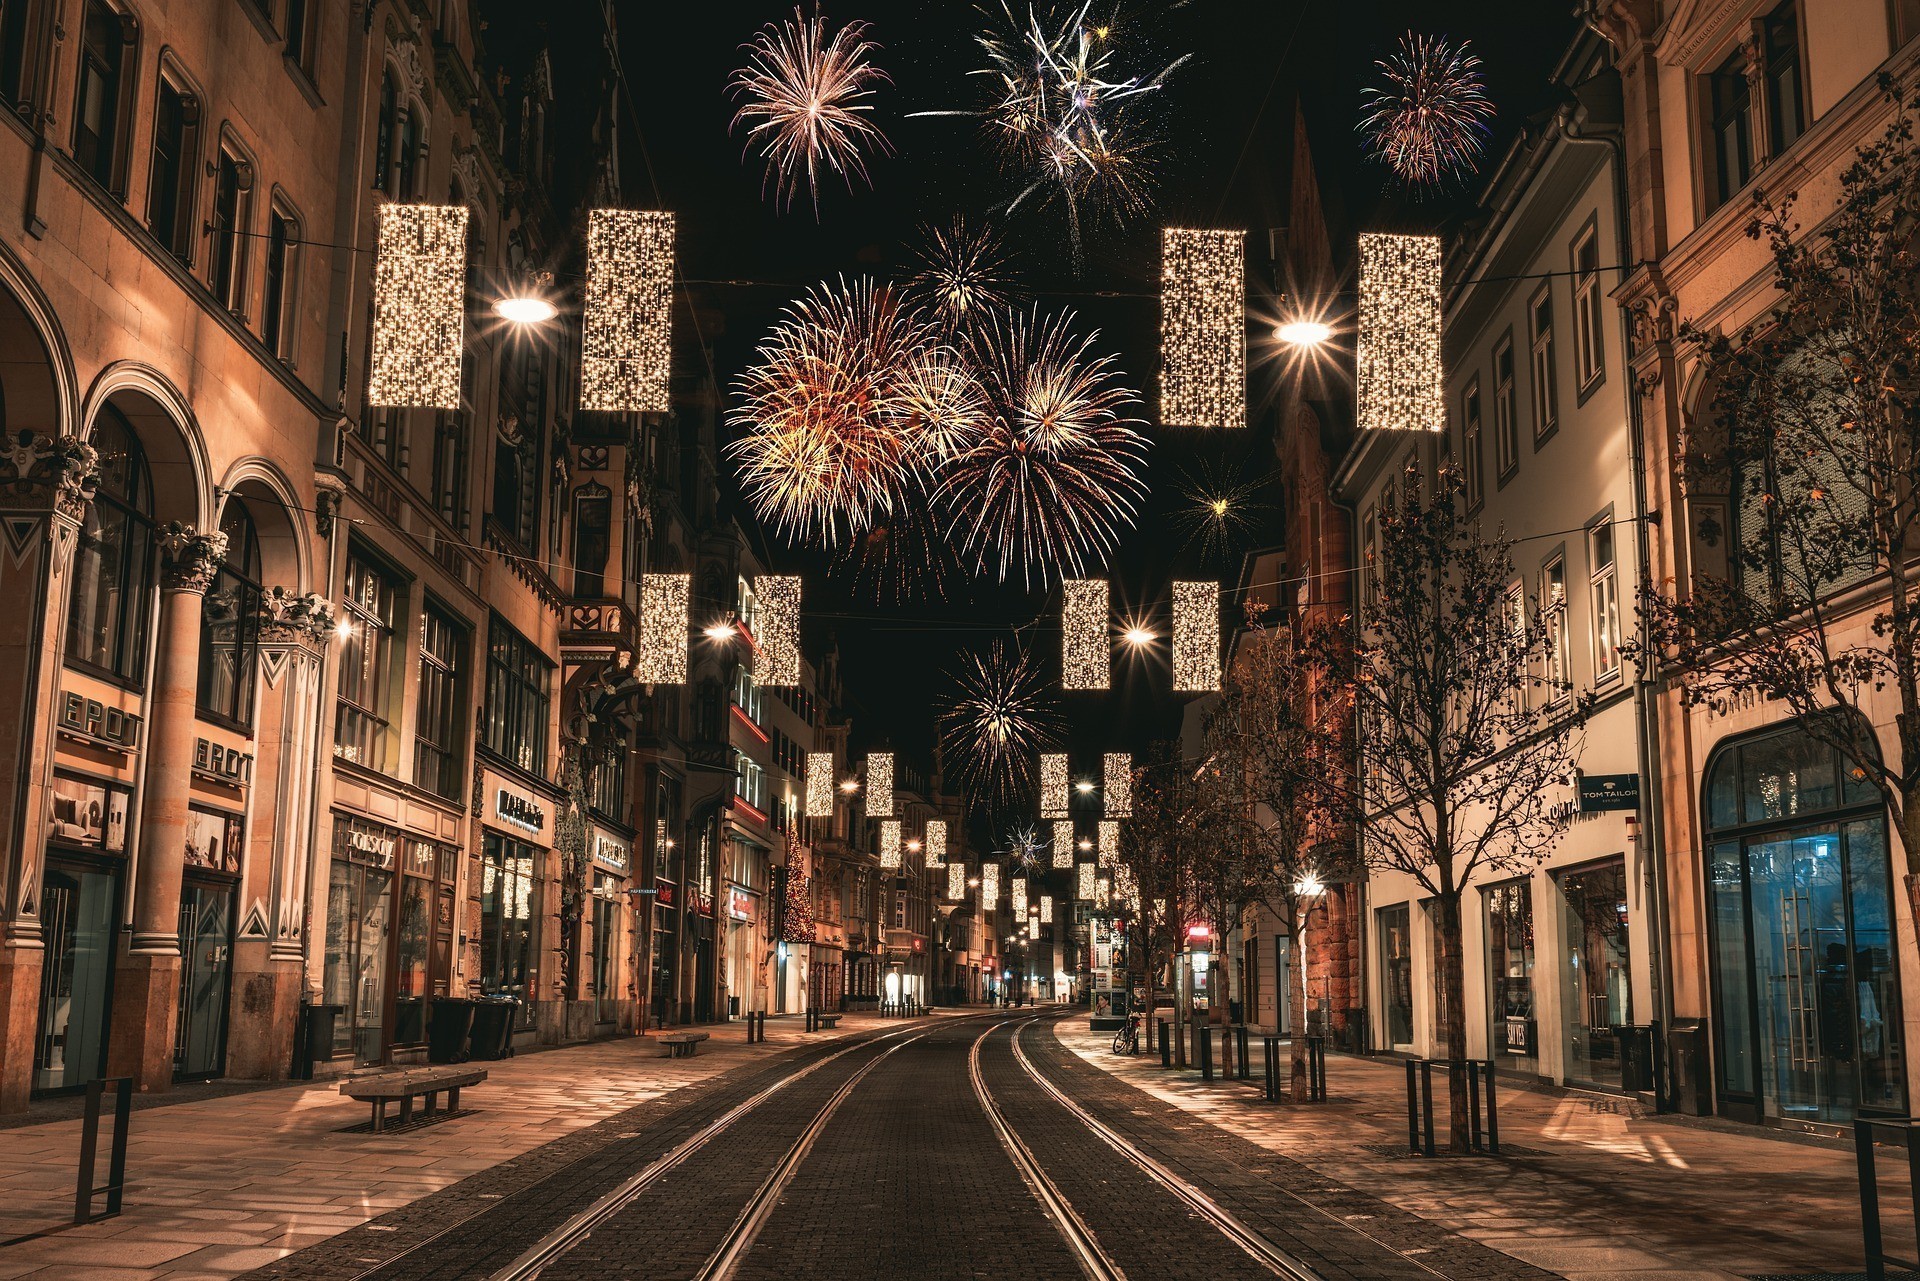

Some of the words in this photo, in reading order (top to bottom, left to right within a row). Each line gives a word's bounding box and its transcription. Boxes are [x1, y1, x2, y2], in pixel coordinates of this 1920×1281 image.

[61, 690, 144, 746] EPOT
[195, 737, 254, 781] EPOT
[1604, 790, 1638, 798] TAILOR
